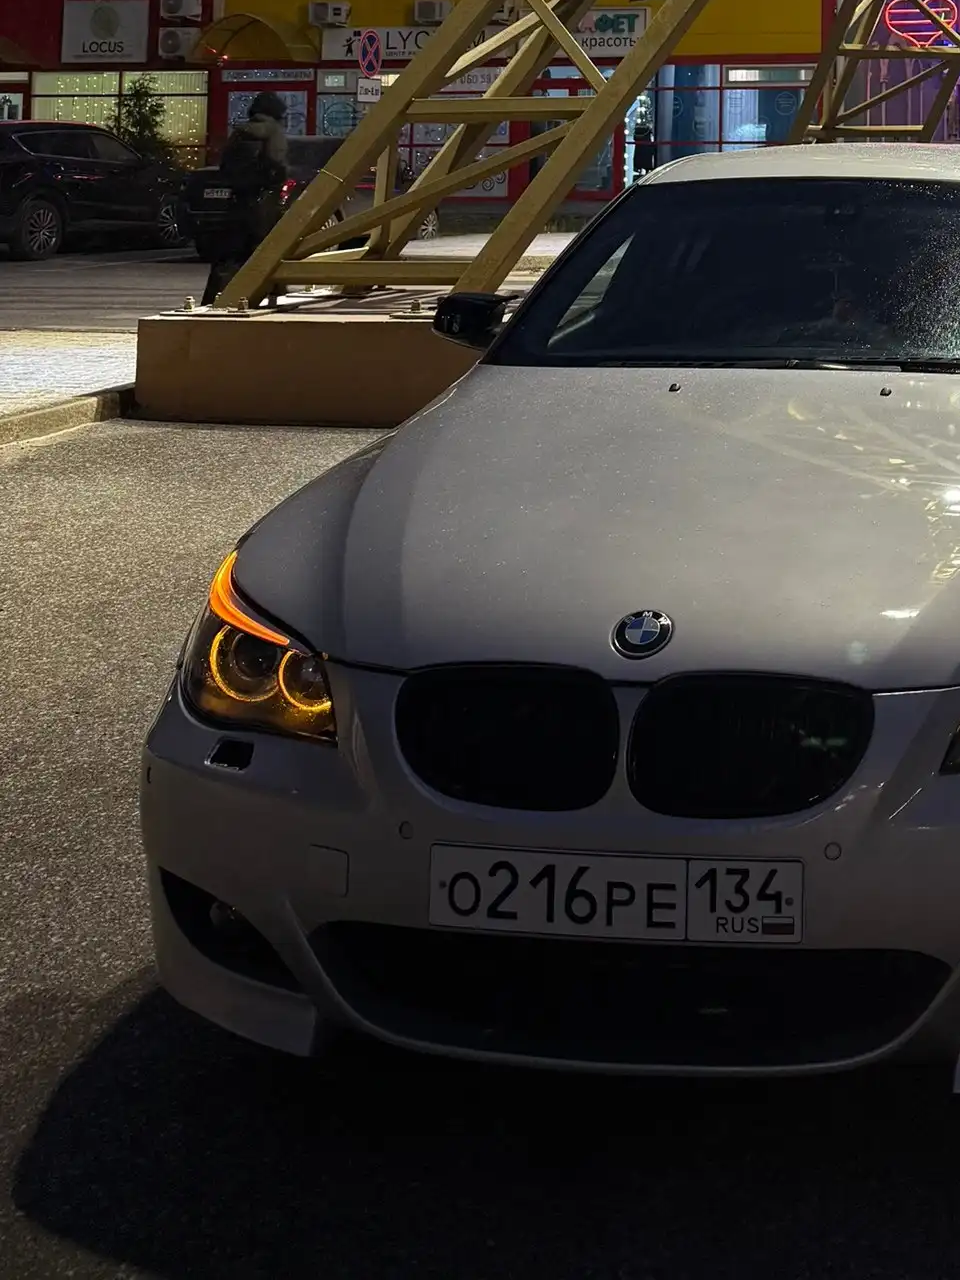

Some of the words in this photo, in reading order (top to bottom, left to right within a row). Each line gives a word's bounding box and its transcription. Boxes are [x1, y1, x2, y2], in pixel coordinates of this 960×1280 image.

[82, 41, 125, 53] LOCUS
[695, 867, 783, 914] 134
[715, 916, 760, 934] RUS
